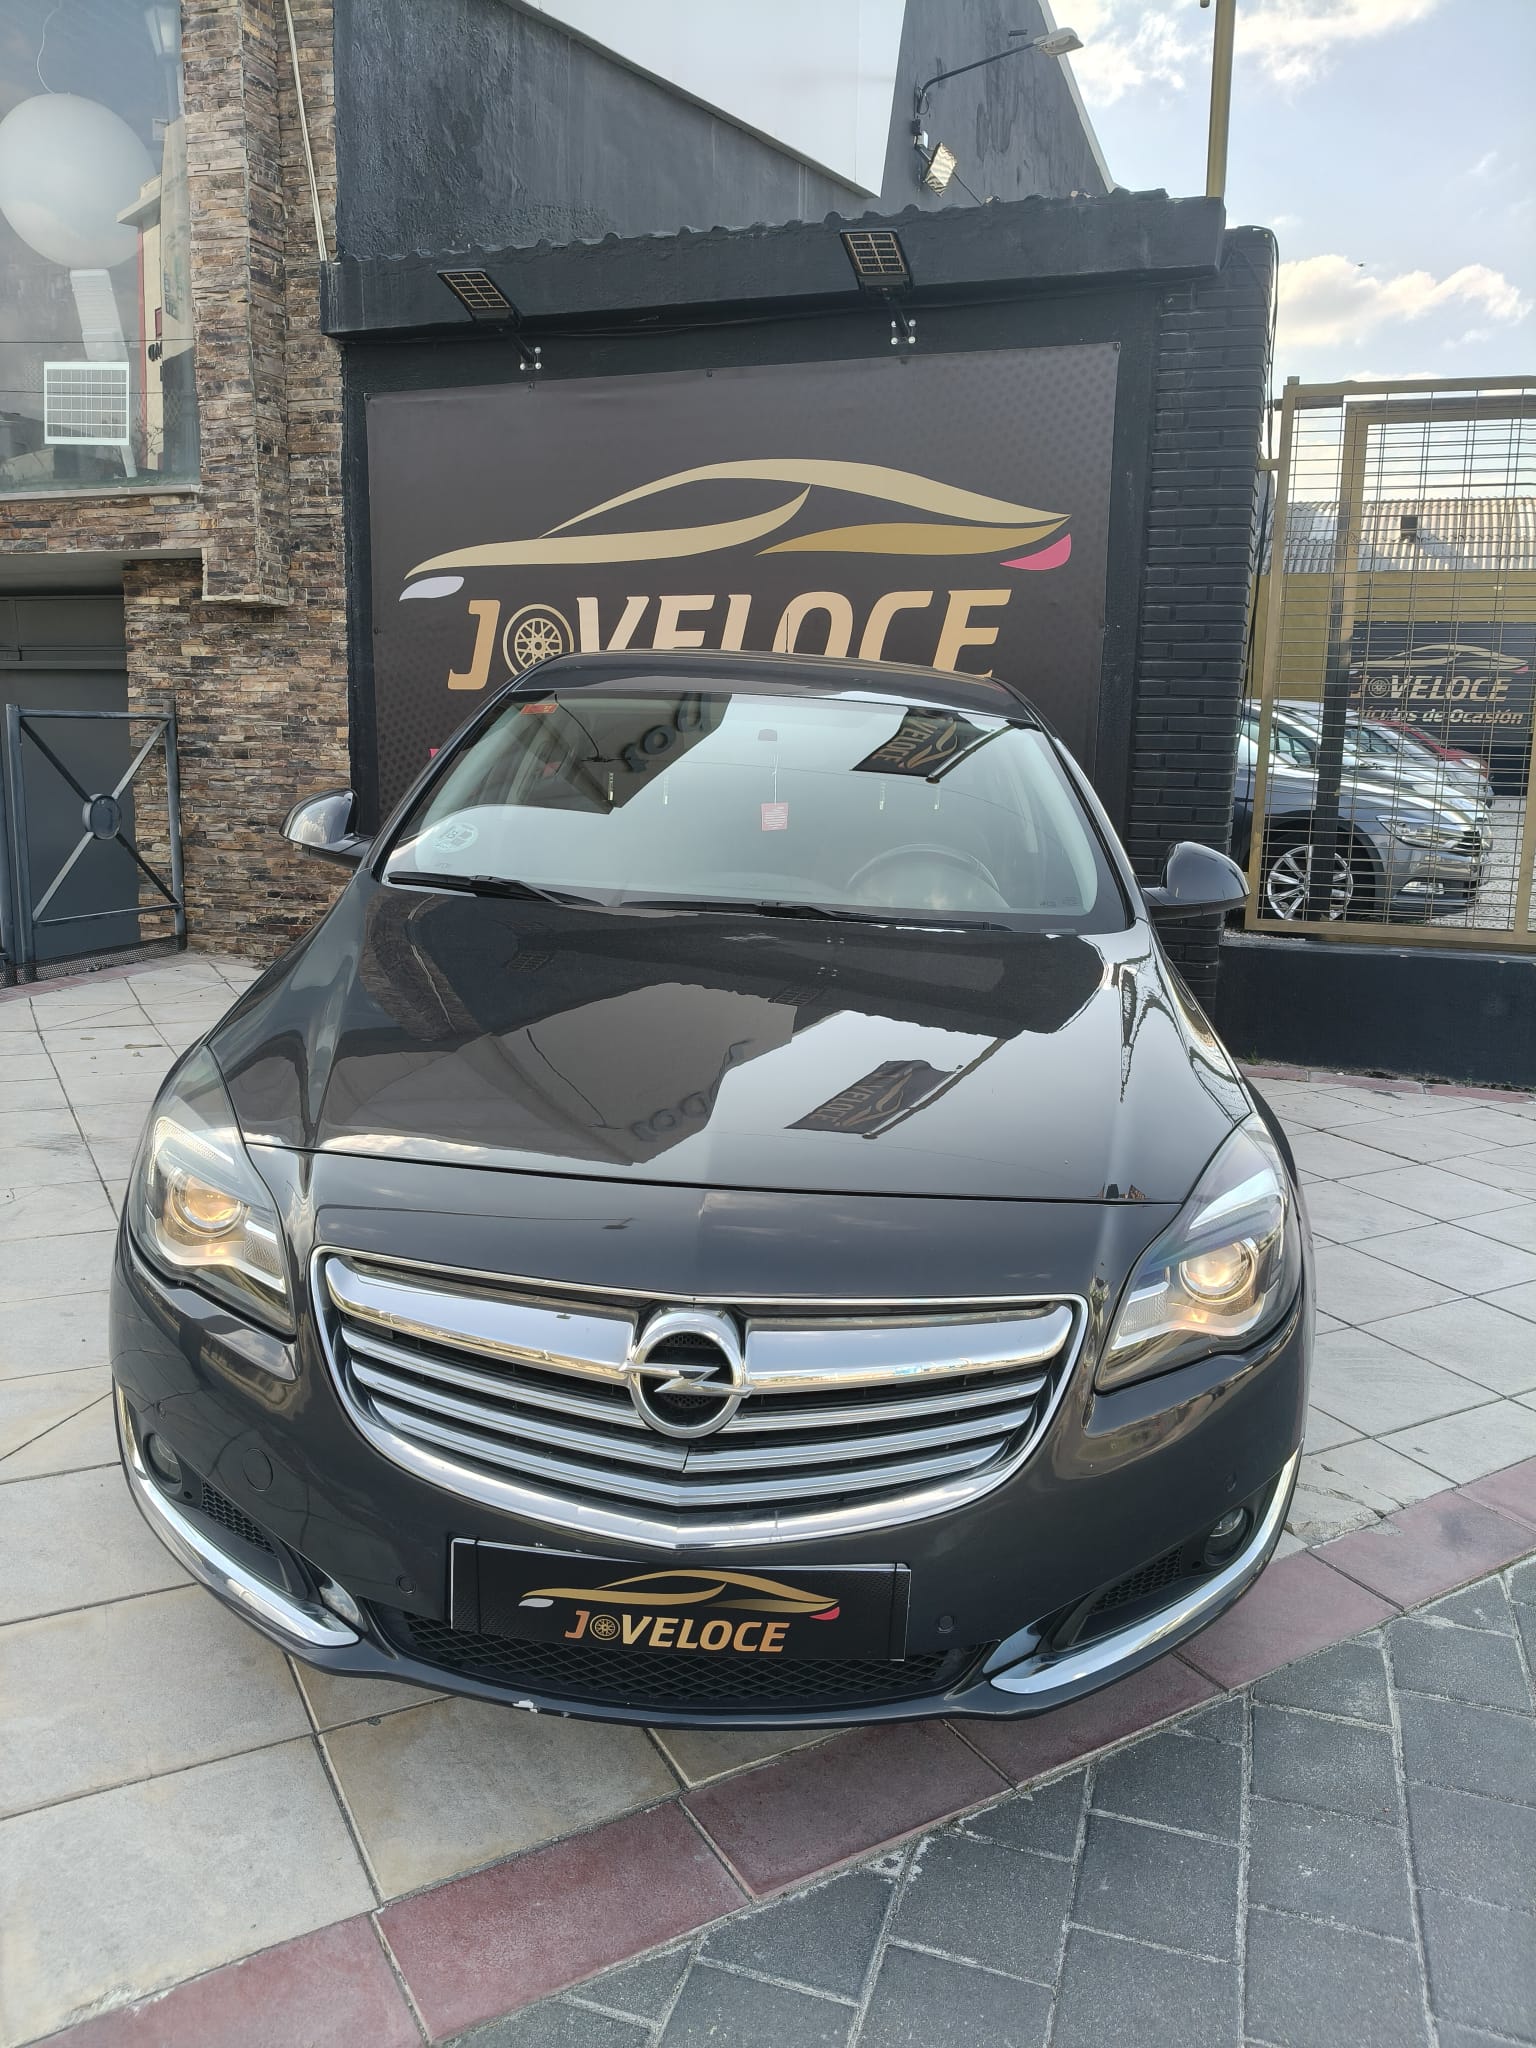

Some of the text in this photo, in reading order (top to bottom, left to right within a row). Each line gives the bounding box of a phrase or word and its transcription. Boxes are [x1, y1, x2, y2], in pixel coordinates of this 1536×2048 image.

[1422, 708, 1442, 723] de
[1450, 709, 1523, 724] Ocasión
[564, 1610, 790, 1652] JOVELOCE
